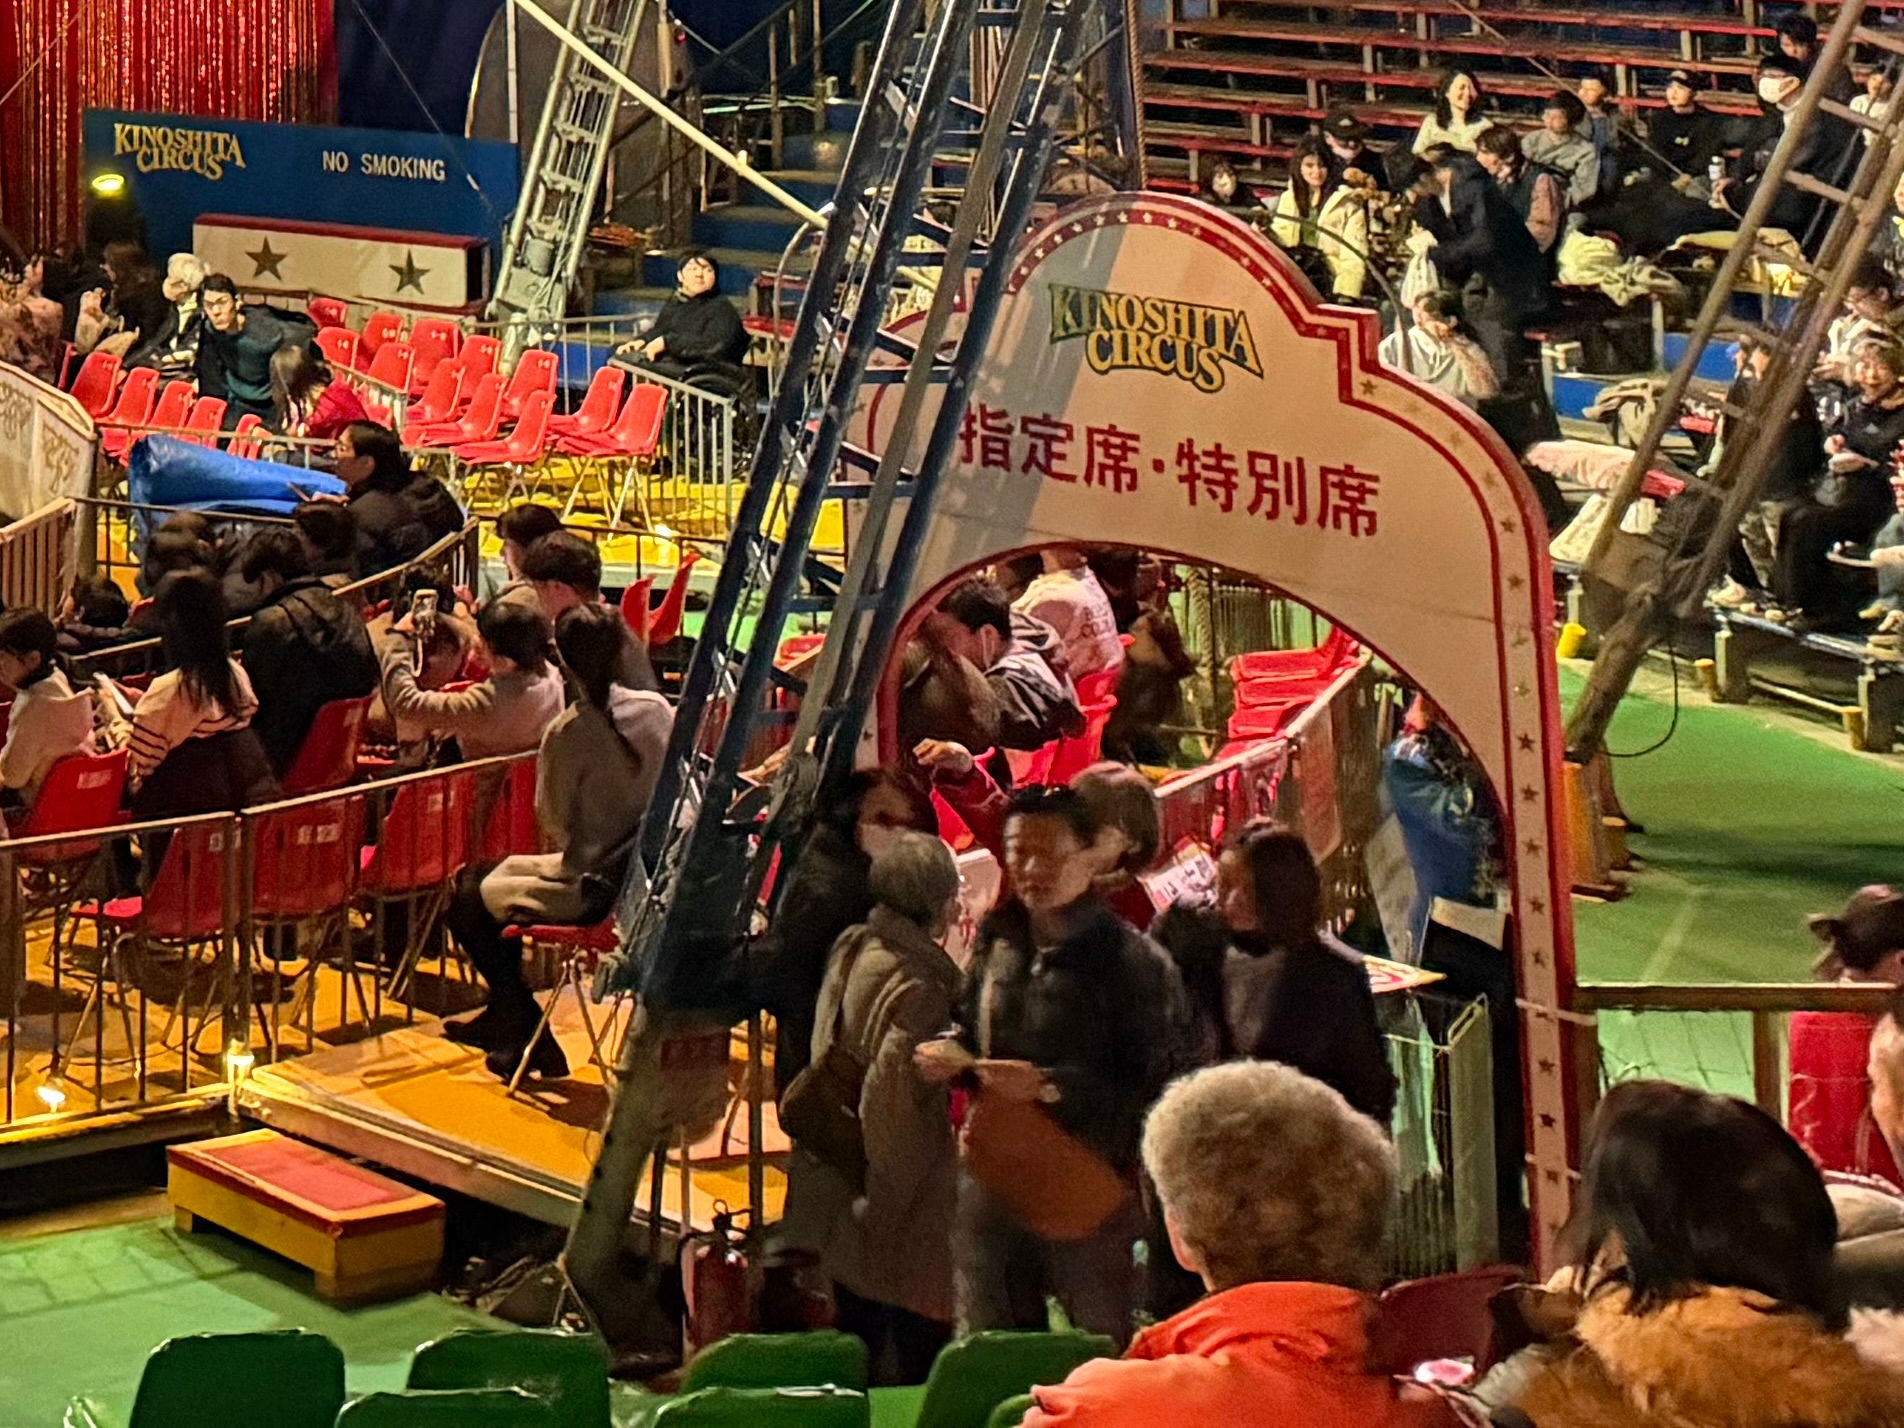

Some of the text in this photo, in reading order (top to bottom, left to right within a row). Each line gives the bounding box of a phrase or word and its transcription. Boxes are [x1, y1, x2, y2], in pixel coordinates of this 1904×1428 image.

[113, 122, 246, 169] KINOSHITA
[137, 147, 224, 181] CIRCUS
[322, 150, 446, 182] NO SMOKING
[1048, 282, 1265, 380] KINOSHITA
[1086, 327, 1226, 393] CIRCUS
